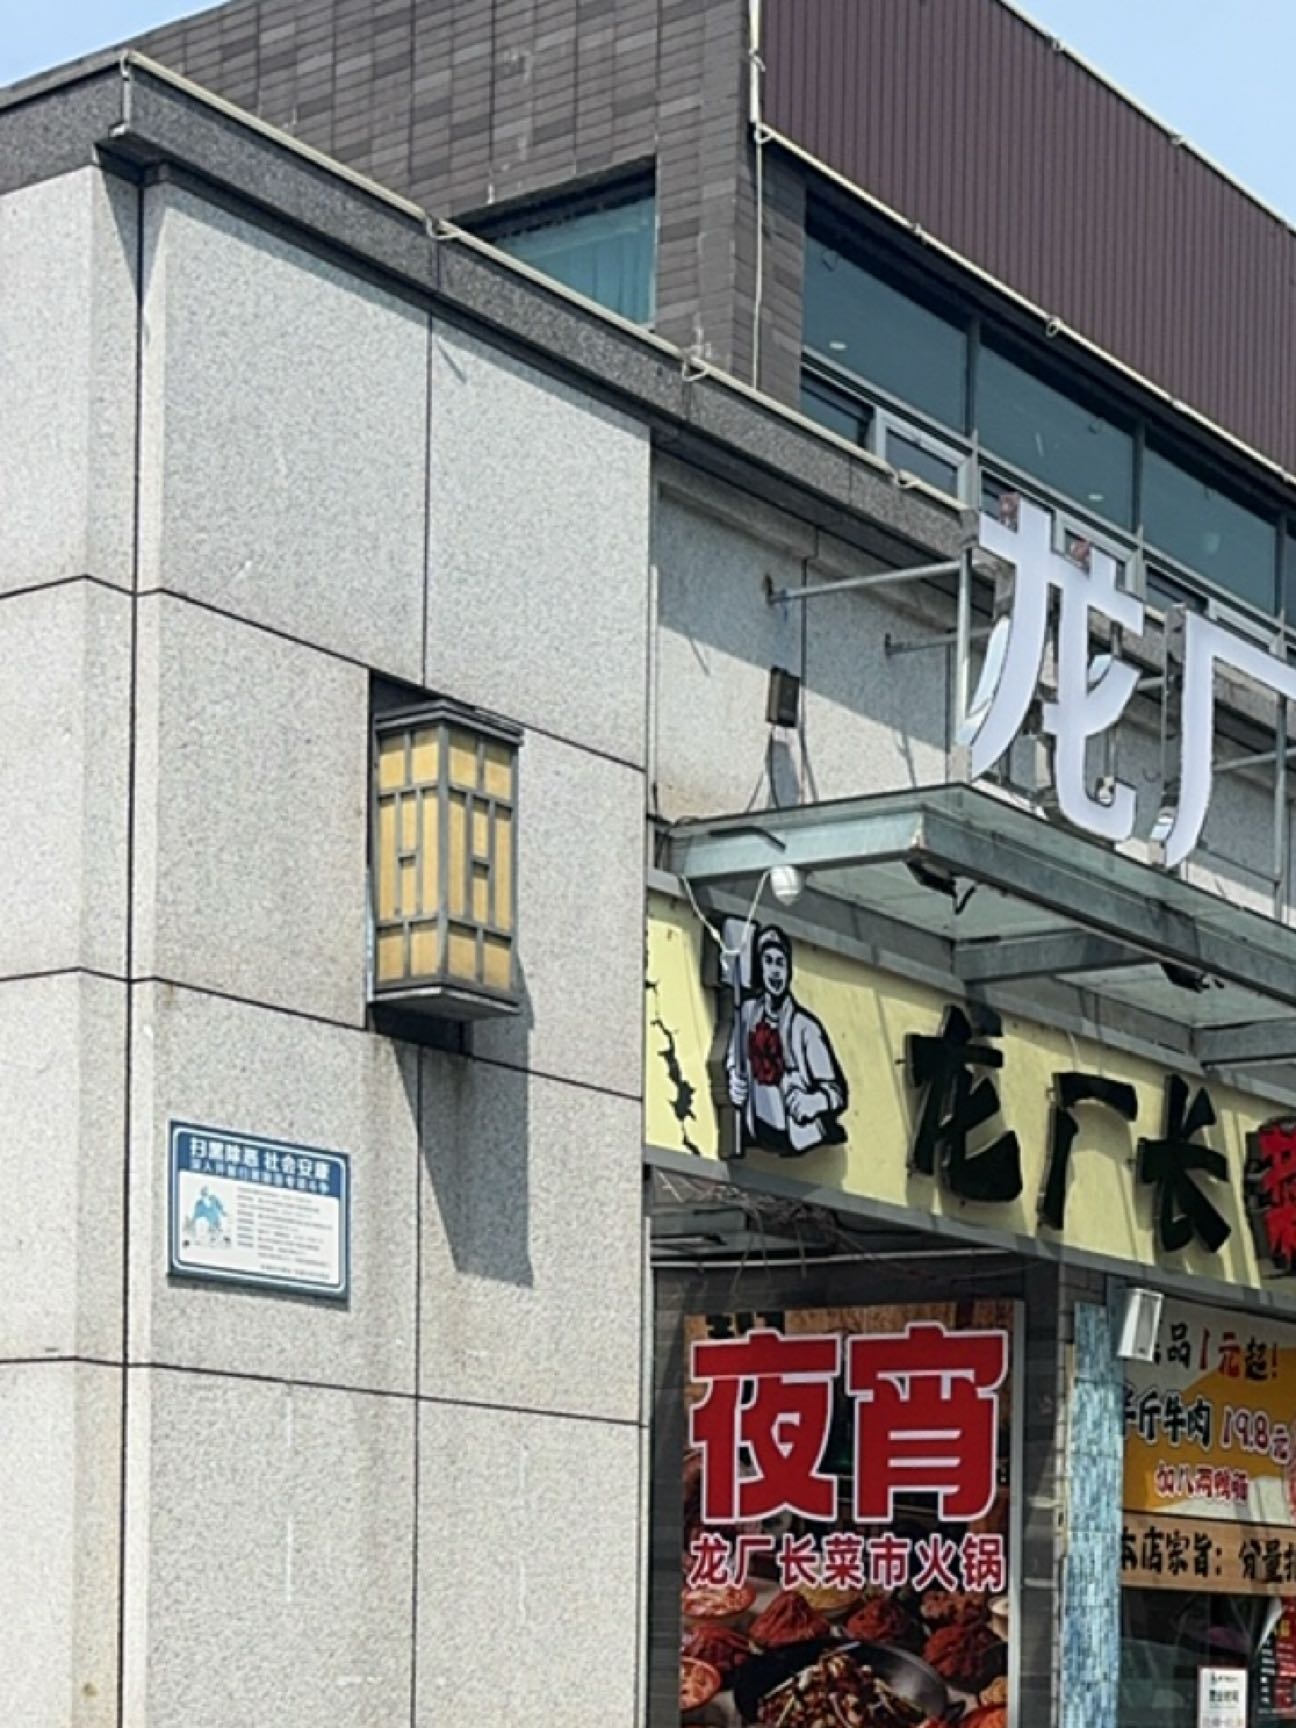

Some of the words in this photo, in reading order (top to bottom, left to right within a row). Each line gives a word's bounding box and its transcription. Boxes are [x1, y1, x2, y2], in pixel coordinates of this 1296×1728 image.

[1153, 1321, 1279, 1381] 品1元起！
[689, 1321, 1009, 1523] 夜宵
[688, 1532, 1008, 1593] 龙厂长菜市火锅
